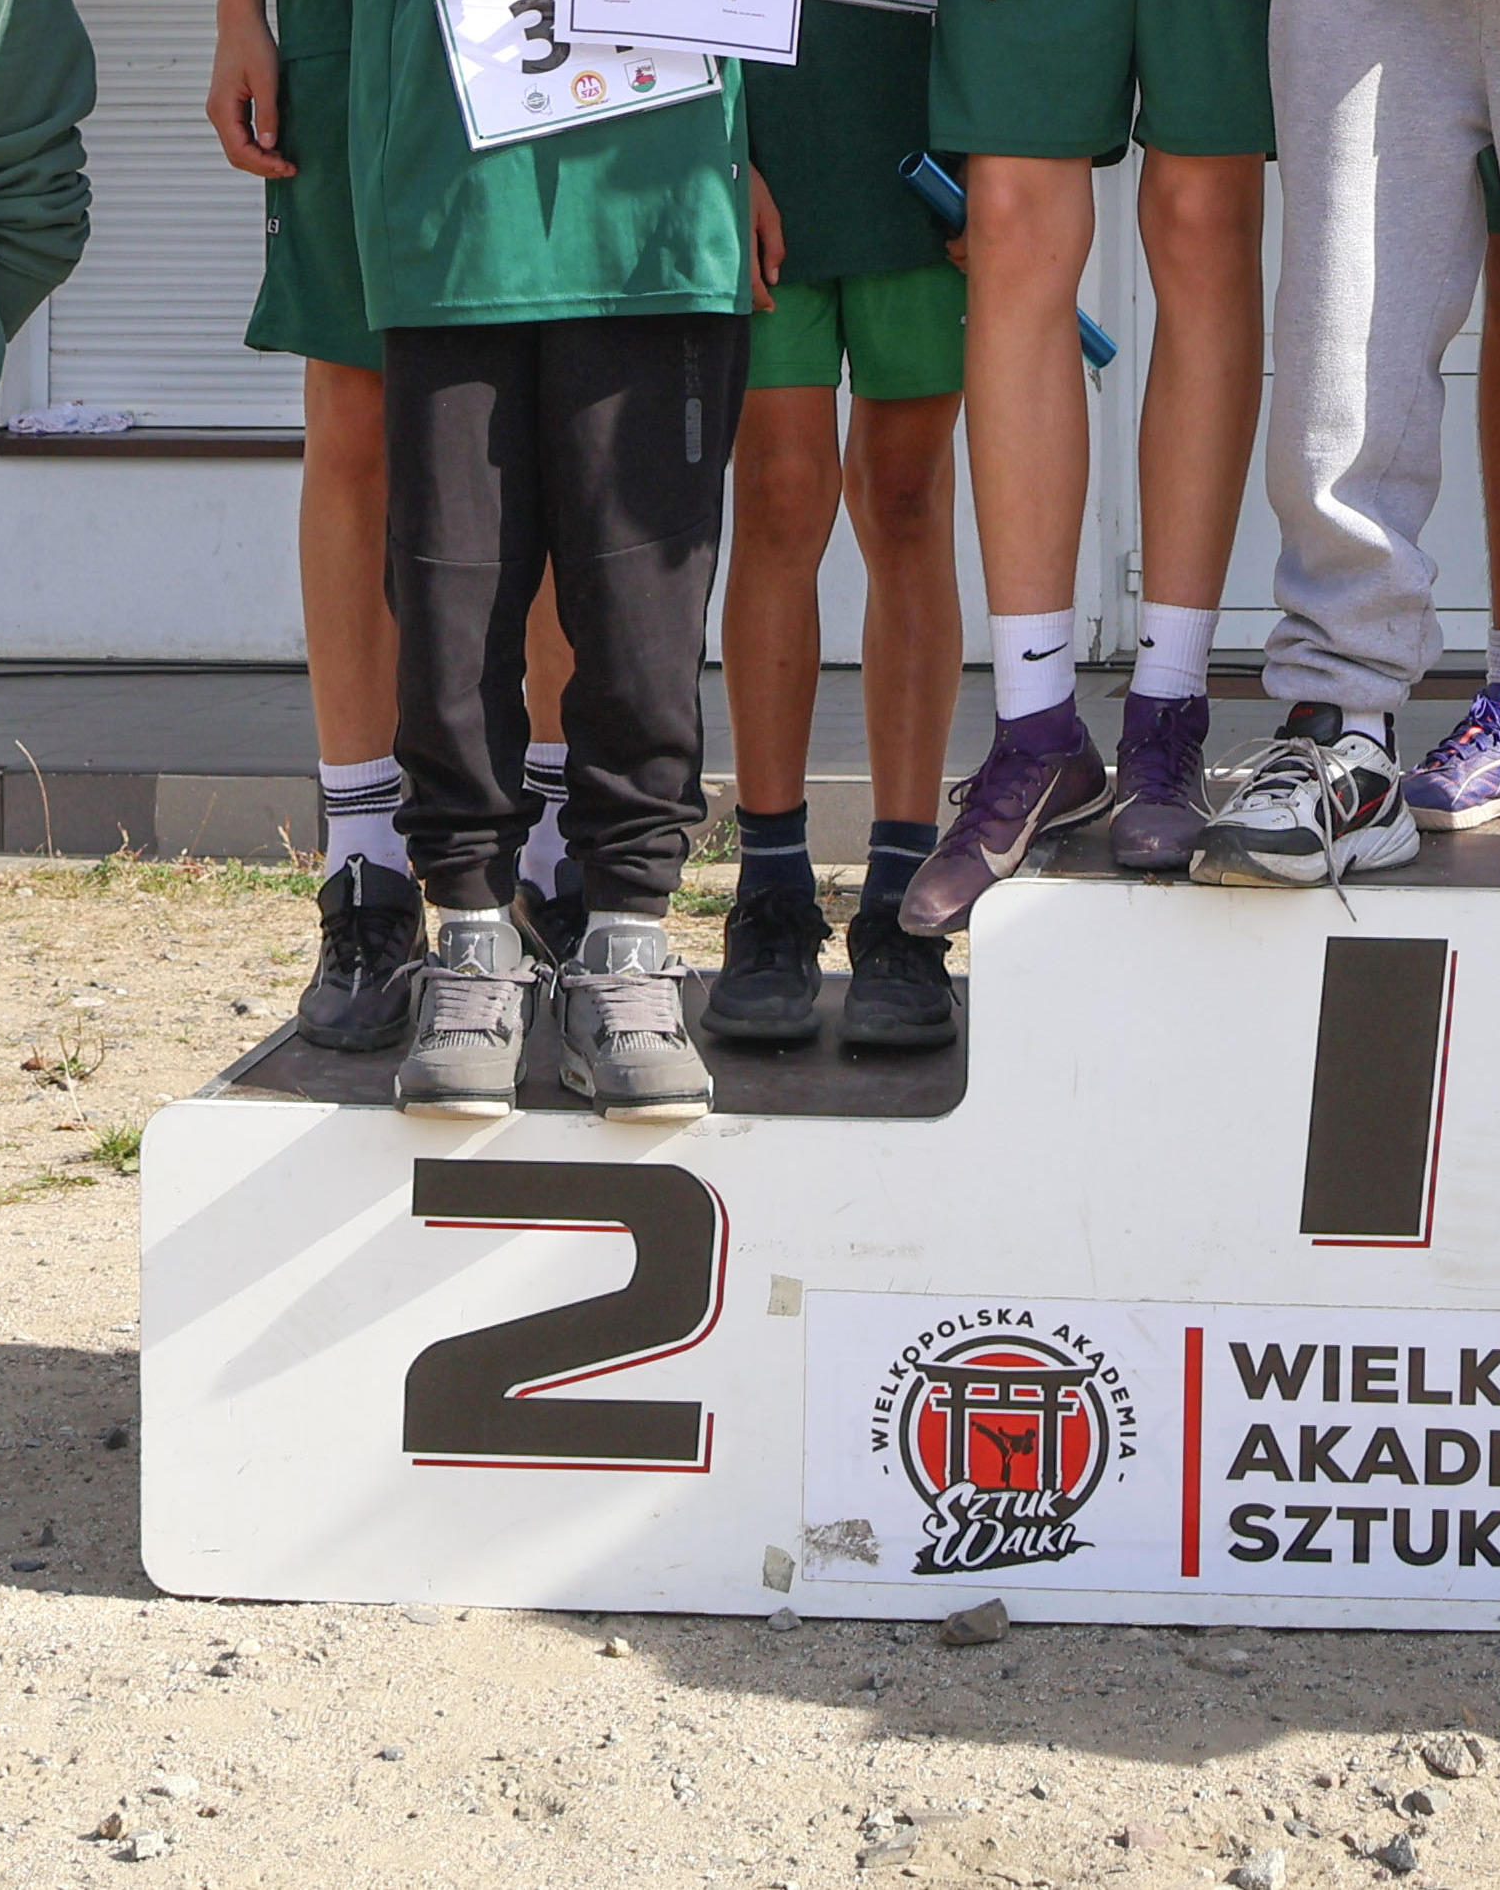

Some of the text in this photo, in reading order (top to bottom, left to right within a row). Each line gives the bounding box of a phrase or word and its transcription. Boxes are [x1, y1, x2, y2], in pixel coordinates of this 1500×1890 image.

[403, 1157, 724, 1466] 2
[871, 1308, 1137, 1460] WIELKOPOLSKA AKADEMIA
[933, 1518, 1075, 1567] WALKI
